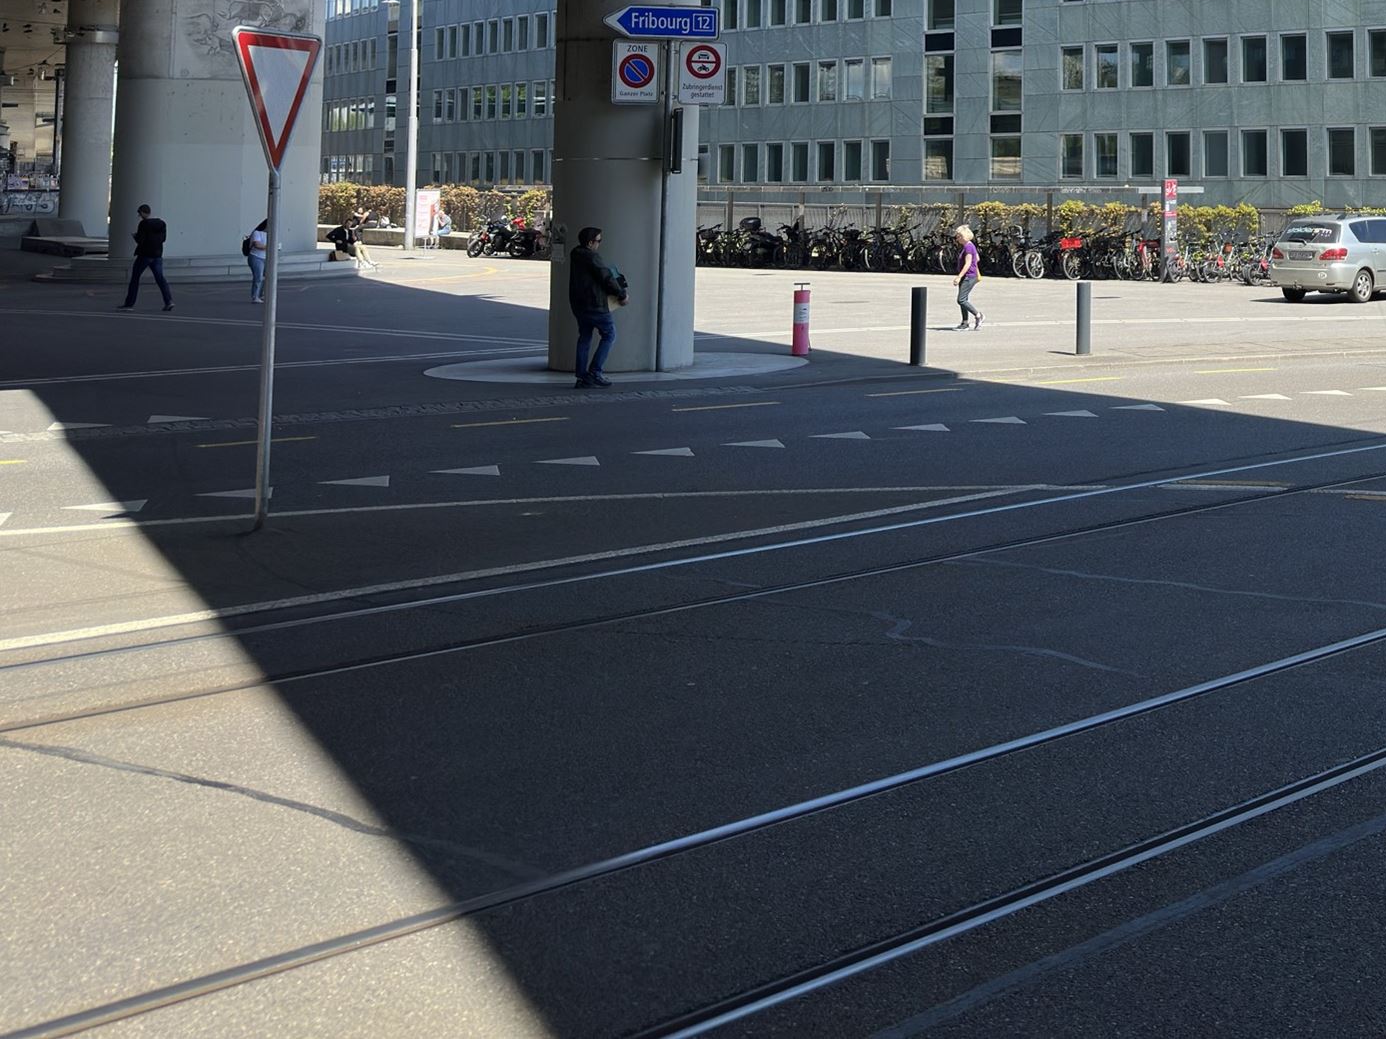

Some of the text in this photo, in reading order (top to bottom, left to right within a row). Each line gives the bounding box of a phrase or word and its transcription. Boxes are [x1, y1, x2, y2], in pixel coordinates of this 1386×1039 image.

[631, 12, 710, 33] Fribourg 12
[627, 45, 648, 53] ZONE
[682, 83, 723, 91] Zubringerdienst
[690, 91, 715, 99] gestattet
